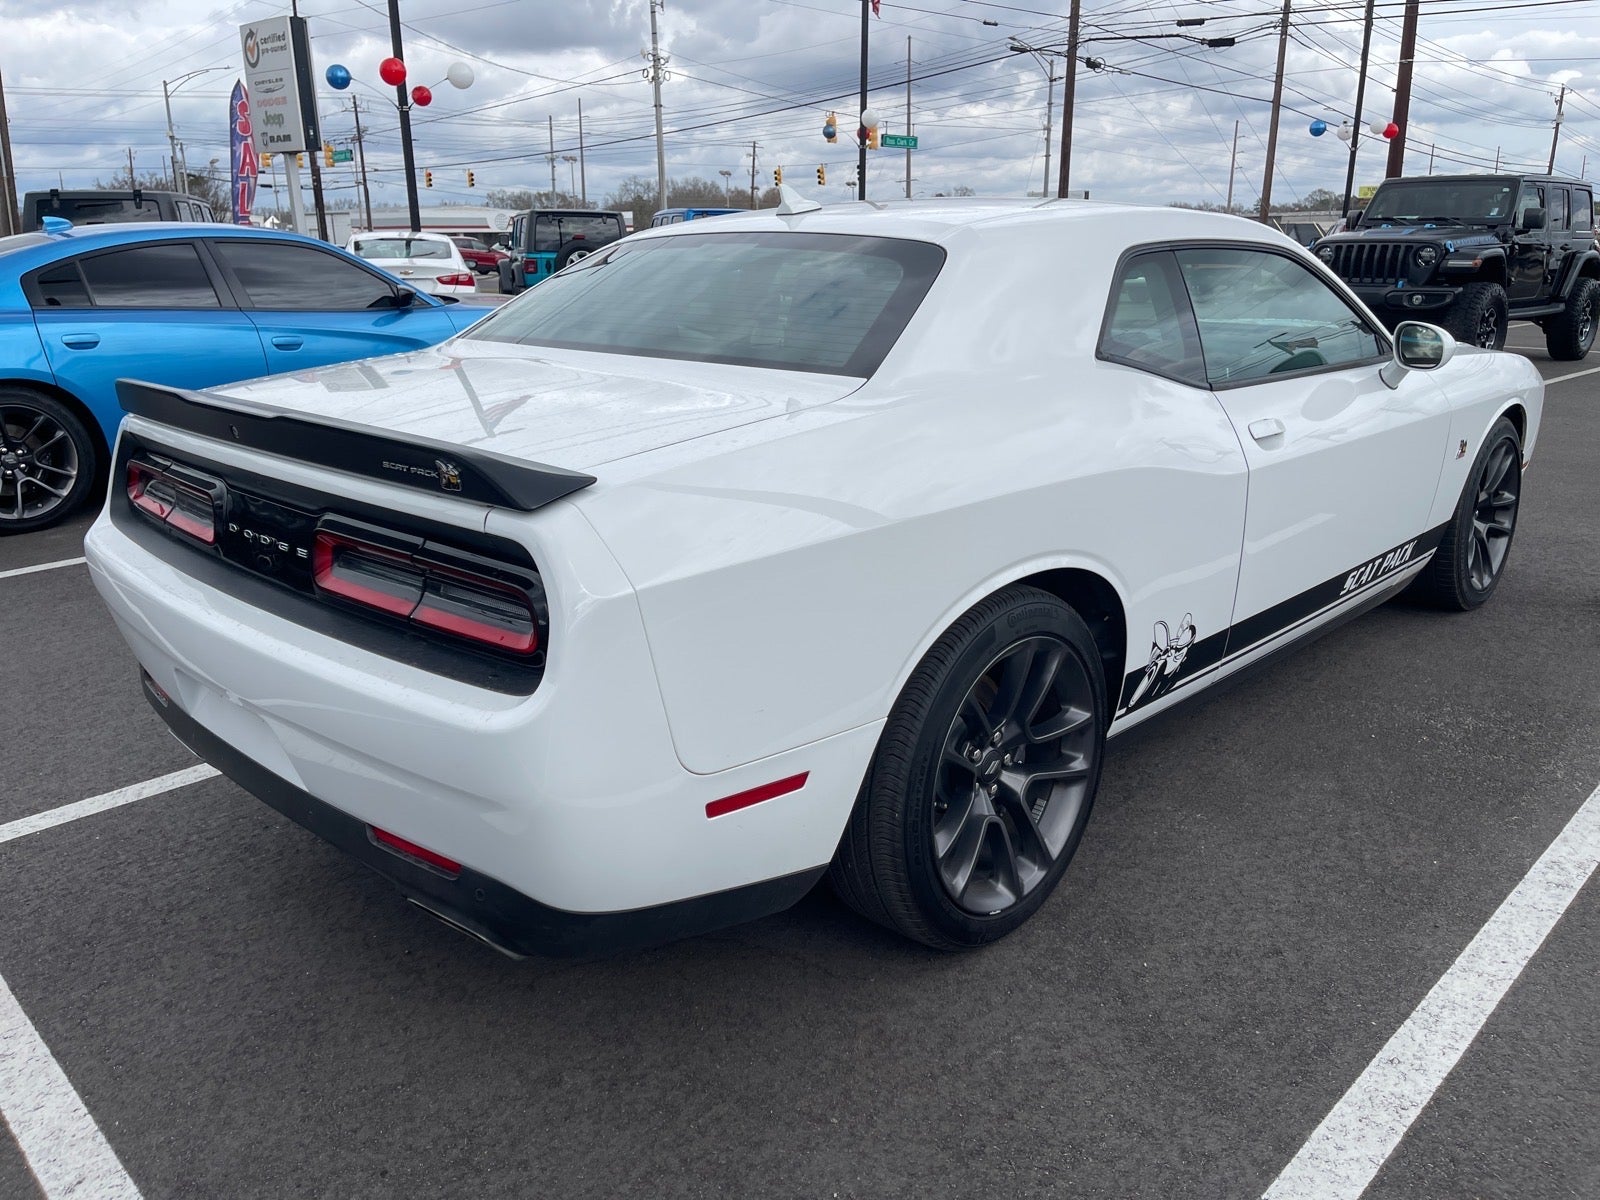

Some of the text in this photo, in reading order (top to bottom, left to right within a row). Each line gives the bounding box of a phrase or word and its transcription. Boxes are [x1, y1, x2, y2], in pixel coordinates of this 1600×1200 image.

[260, 31, 286, 46] certified
[261, 44, 288, 56] pre-owned
[254, 77, 283, 87] CHRYSLER
[256, 96, 288, 108] DODGE
[263, 111, 285, 128] Jeep
[269, 134, 292, 145] RAM
[896, 137, 907, 146] Clark
[236, 99, 257, 226] SAL
[382, 461, 439, 479] SCAT PACK
[229, 522, 308, 559] DODGE
[1339, 540, 1418, 596] SCAT PACK
